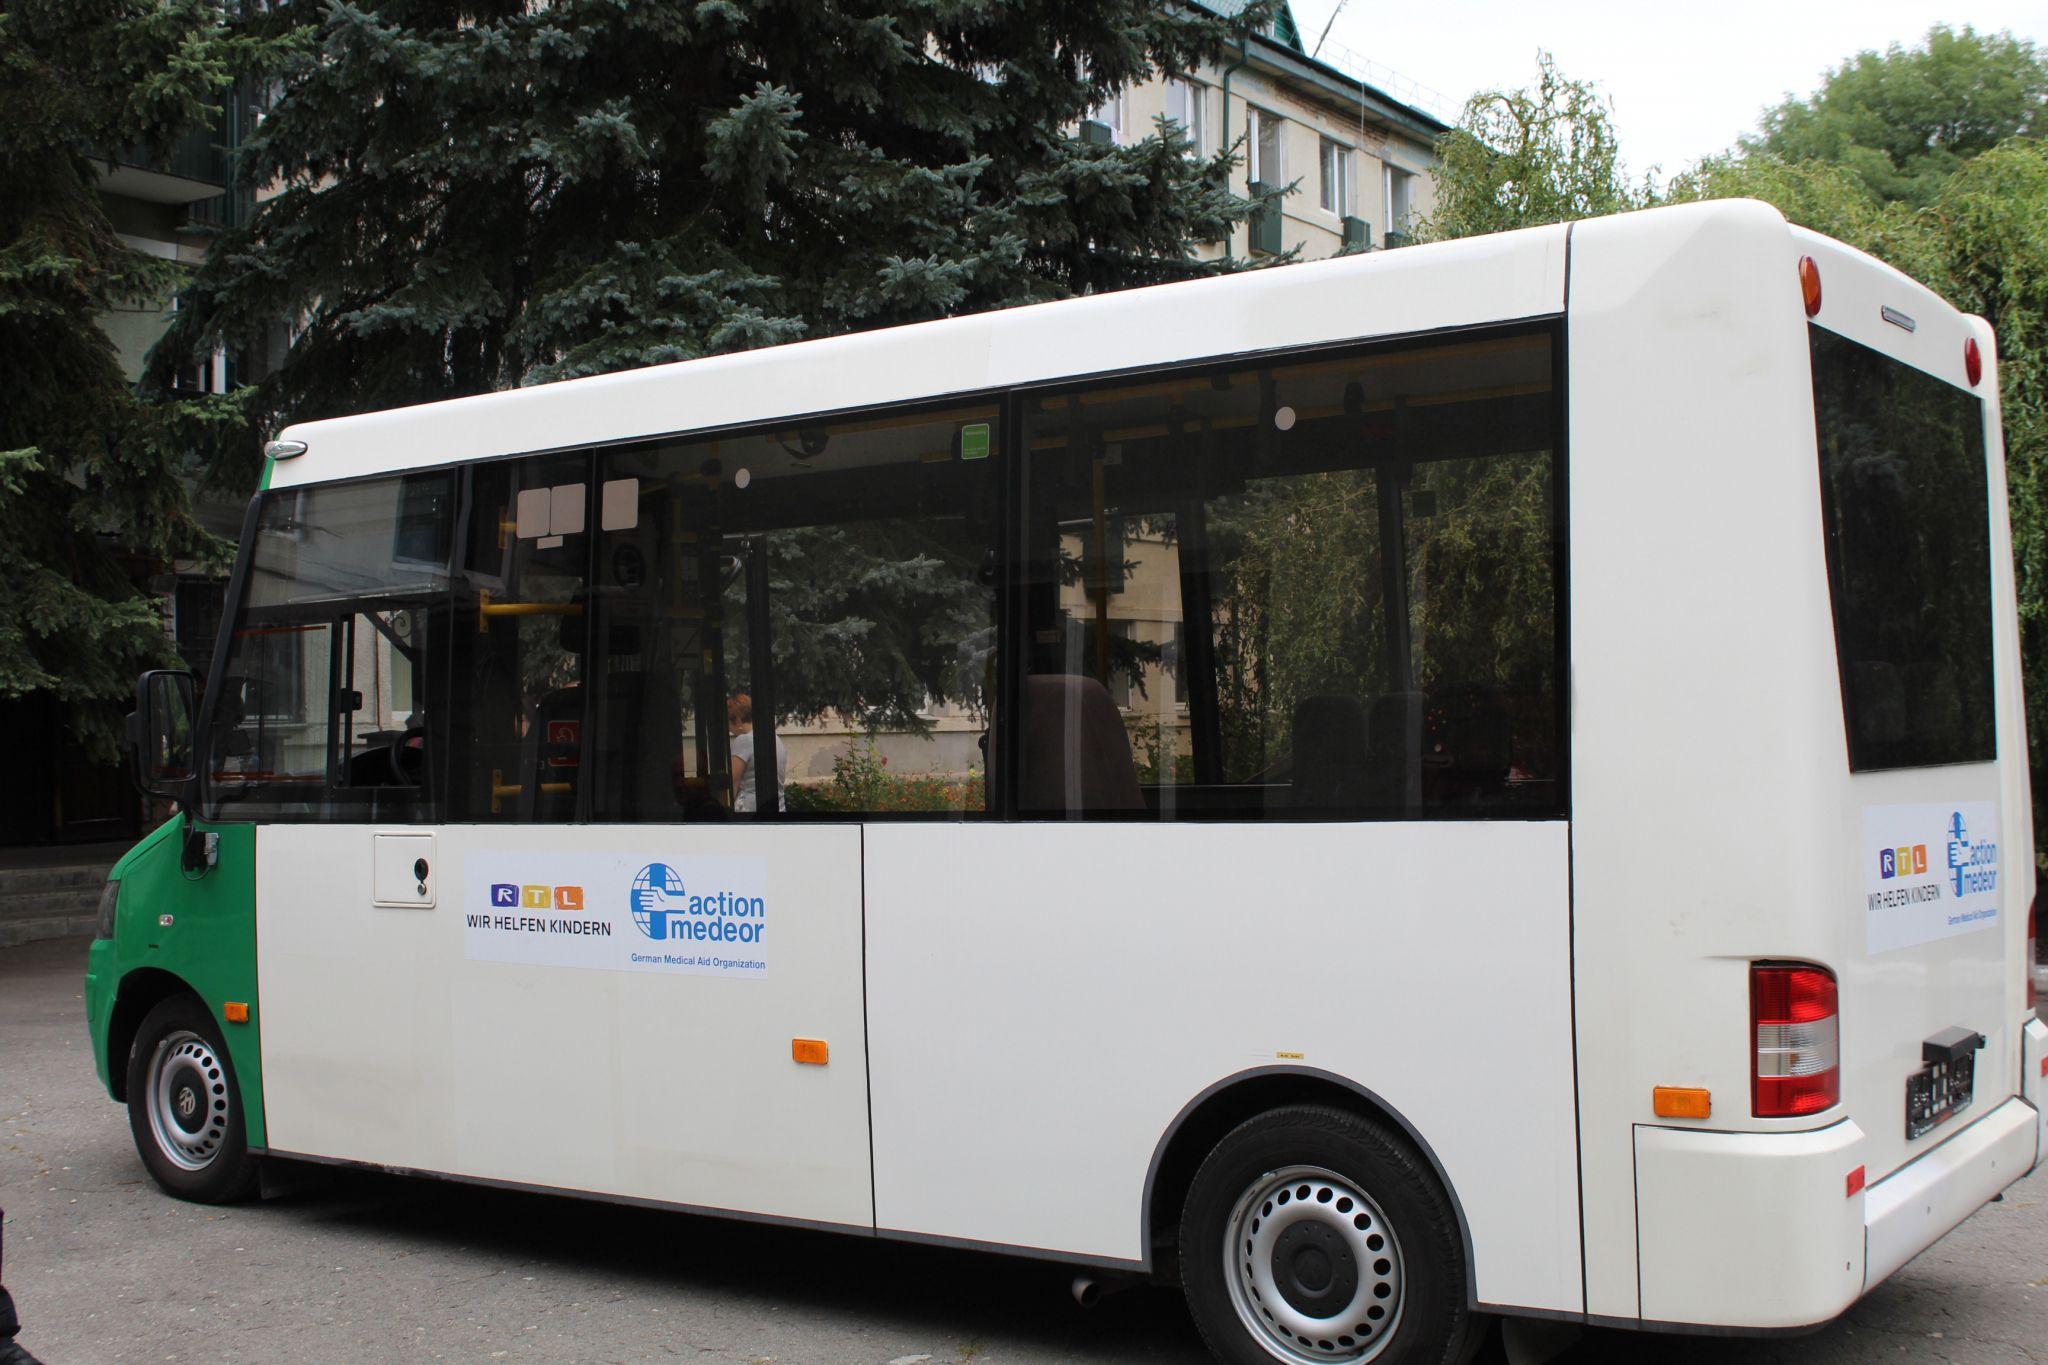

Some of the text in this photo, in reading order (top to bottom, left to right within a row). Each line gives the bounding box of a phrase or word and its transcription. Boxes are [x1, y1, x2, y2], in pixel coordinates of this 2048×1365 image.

[1881, 848, 1926, 876] RTL
[1970, 840, 1996, 866] action
[1964, 867, 1996, 893] medeor
[494, 886, 580, 908] RTL
[689, 892, 764, 917] action
[1867, 883, 1940, 911] WIR HELFEN KINDERN
[467, 914, 611, 936] WIR HELFEN KINDERN
[671, 916, 765, 943] medeor
[631, 953, 766, 970] German Medical Aid Organization
